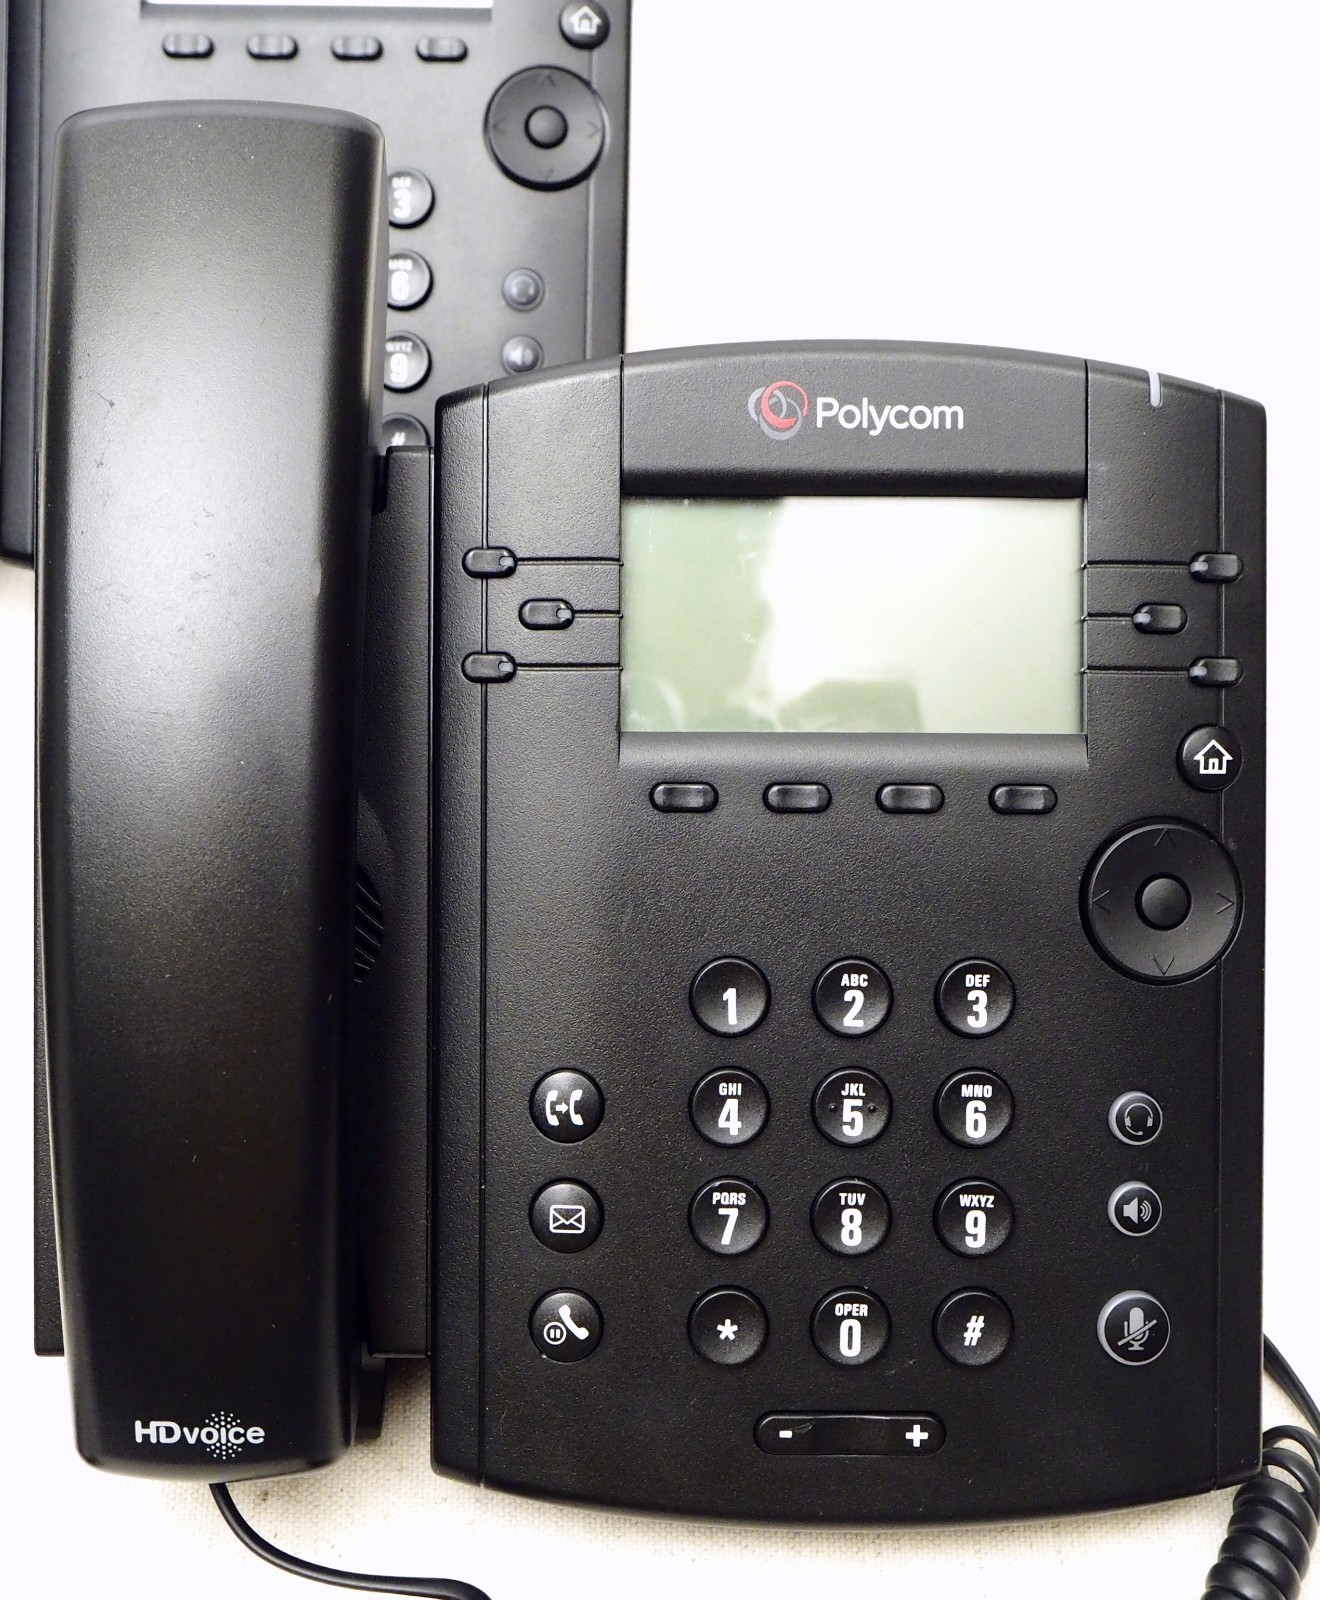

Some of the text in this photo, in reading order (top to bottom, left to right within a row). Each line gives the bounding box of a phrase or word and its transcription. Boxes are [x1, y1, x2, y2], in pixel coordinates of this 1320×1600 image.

[393, 188, 411, 219] 3
[390, 353, 408, 383] 9
[816, 397, 964, 436] Polycom
[840, 973, 868, 988] ABC
[965, 974, 991, 988] DEF
[722, 987, 738, 1026] 1
[843, 989, 864, 1028] 2
[966, 989, 988, 1029] 3
[718, 1082, 742, 1096] GHI
[840, 1082, 866, 1097] JKL
[961, 1084, 993, 1099] MNO
[717, 1098, 742, 1136] 4
[841, 1098, 864, 1137] 5
[965, 1099, 987, 1139] 6
[712, 1191, 747, 1206] PQRS
[839, 1192, 866, 1206] TUV
[959, 1194, 995, 1208] WXYZ
[717, 1207, 739, 1246] 7
[840, 1207, 863, 1247] 8
[964, 1209, 987, 1249] 9
[834, 1302, 869, 1317] OPER
[839, 1318, 862, 1358] 0
[963, 1315, 985, 1347] #
